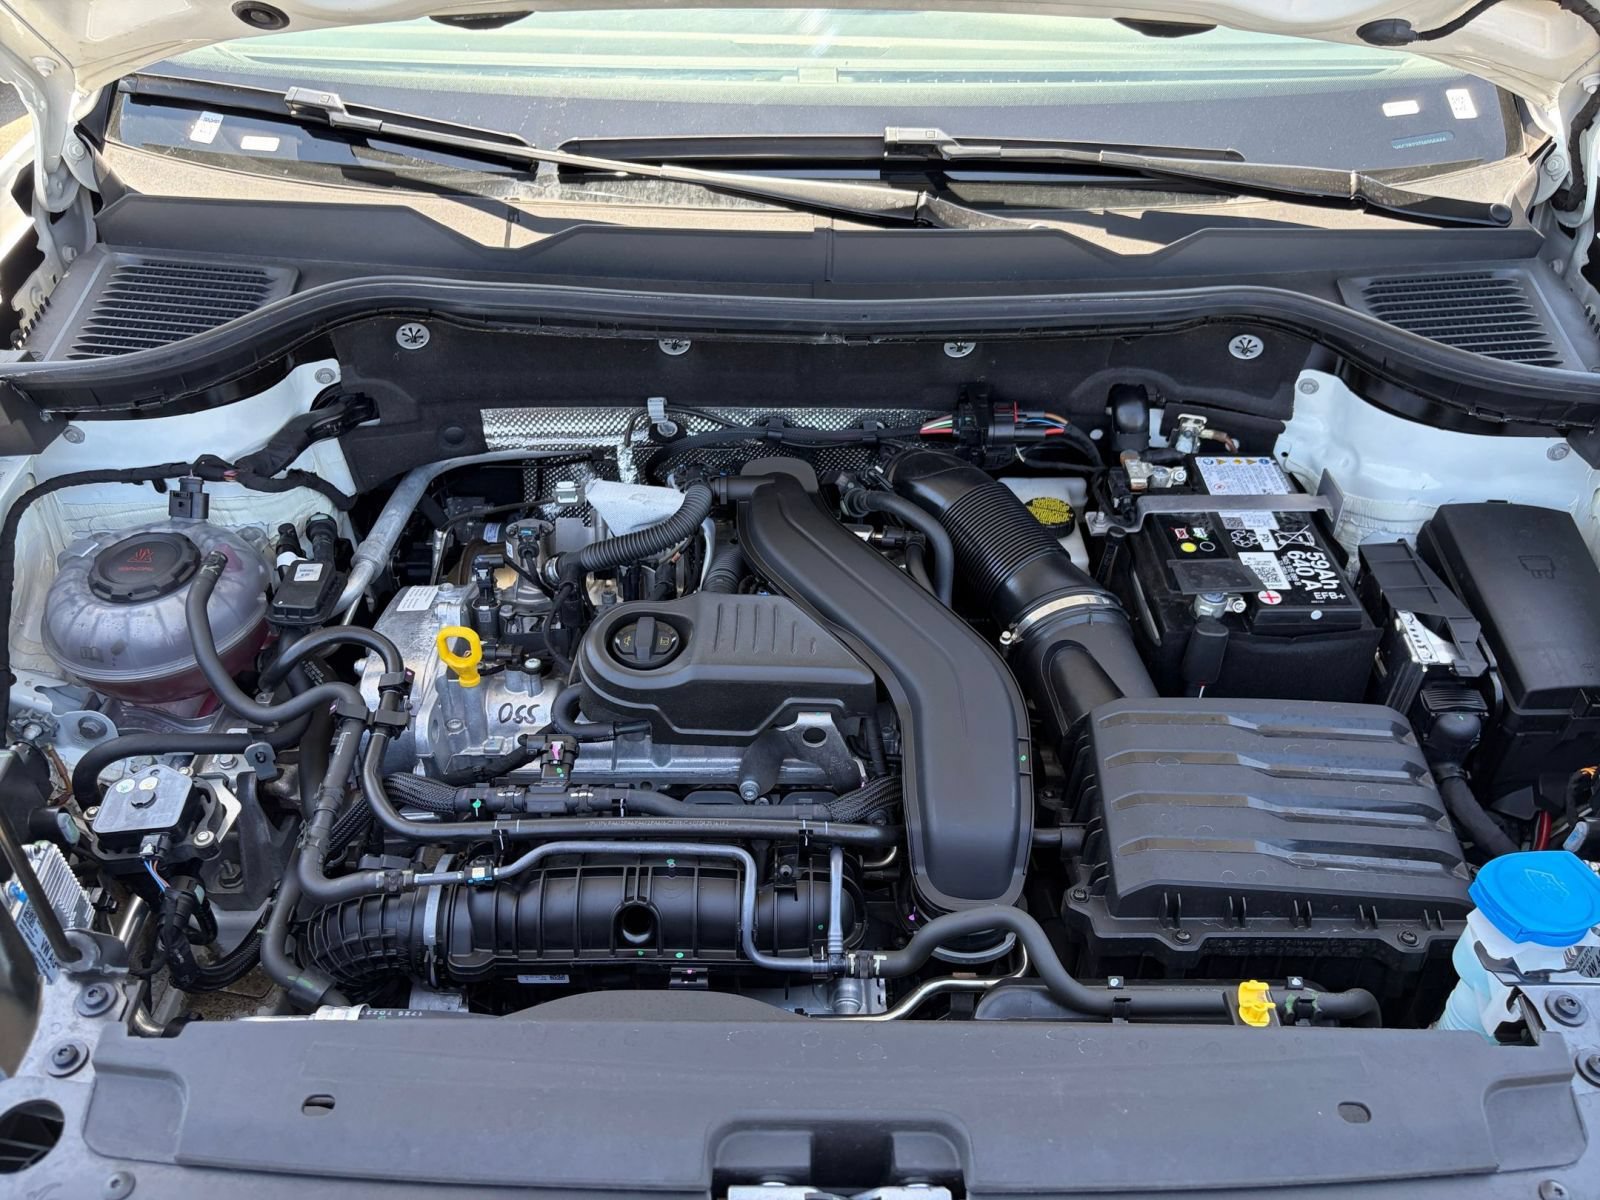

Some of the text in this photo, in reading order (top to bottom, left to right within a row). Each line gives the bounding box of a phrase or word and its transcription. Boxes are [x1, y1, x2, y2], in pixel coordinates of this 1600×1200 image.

[1287, 550, 1315, 577] 640
[1306, 551, 1340, 589] 59Ah
[1300, 579, 1323, 591] A
[1313, 592, 1346, 600] EFB+
